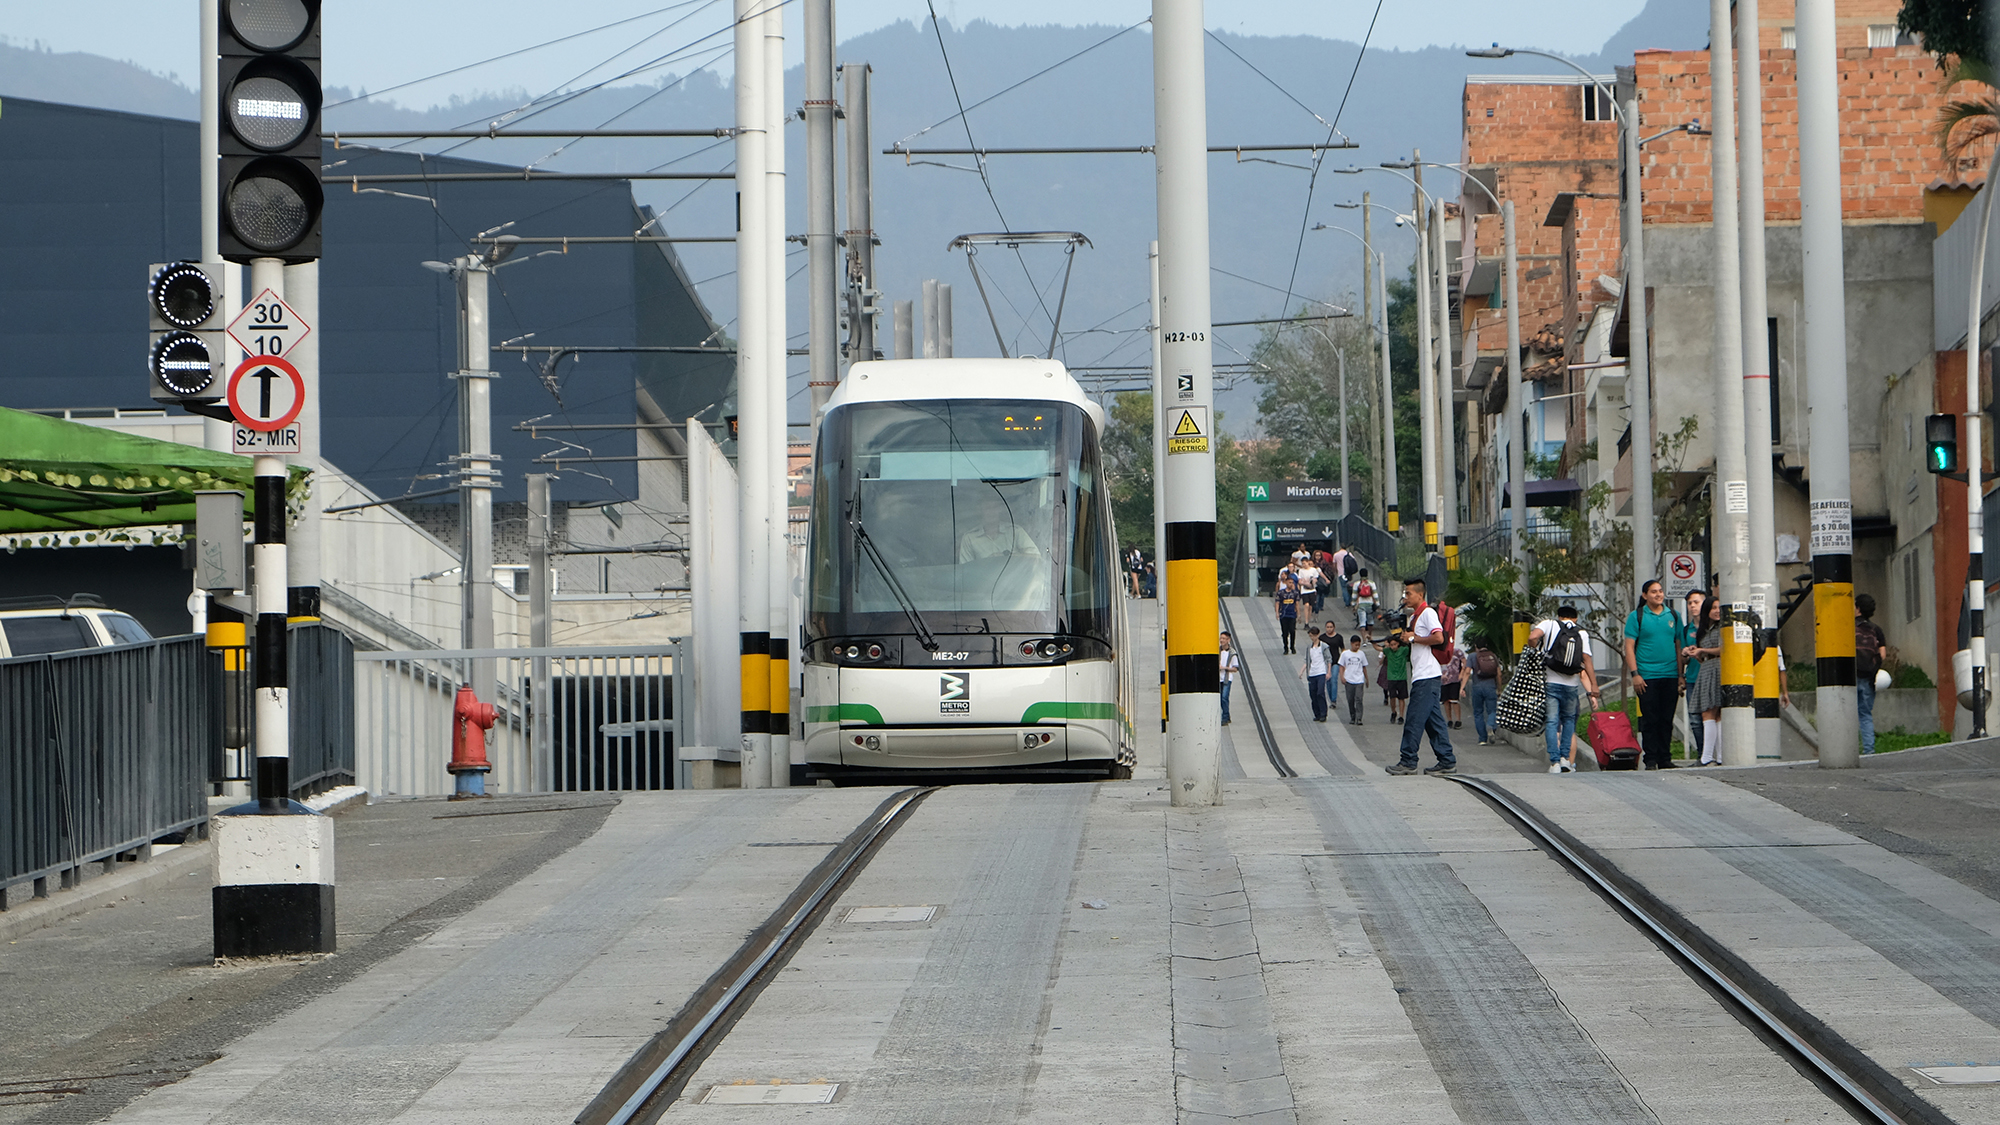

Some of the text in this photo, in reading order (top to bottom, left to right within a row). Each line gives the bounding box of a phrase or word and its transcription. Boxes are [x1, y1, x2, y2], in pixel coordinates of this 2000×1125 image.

[254, 303, 282, 324] 30
[1165, 332, 1205, 343] H22-03
[254, 335, 282, 355] 10
[267, 429, 297, 446] MIR
[1286, 486, 1343, 496] Miraflores
[932, 652, 969, 661] ME2-07
